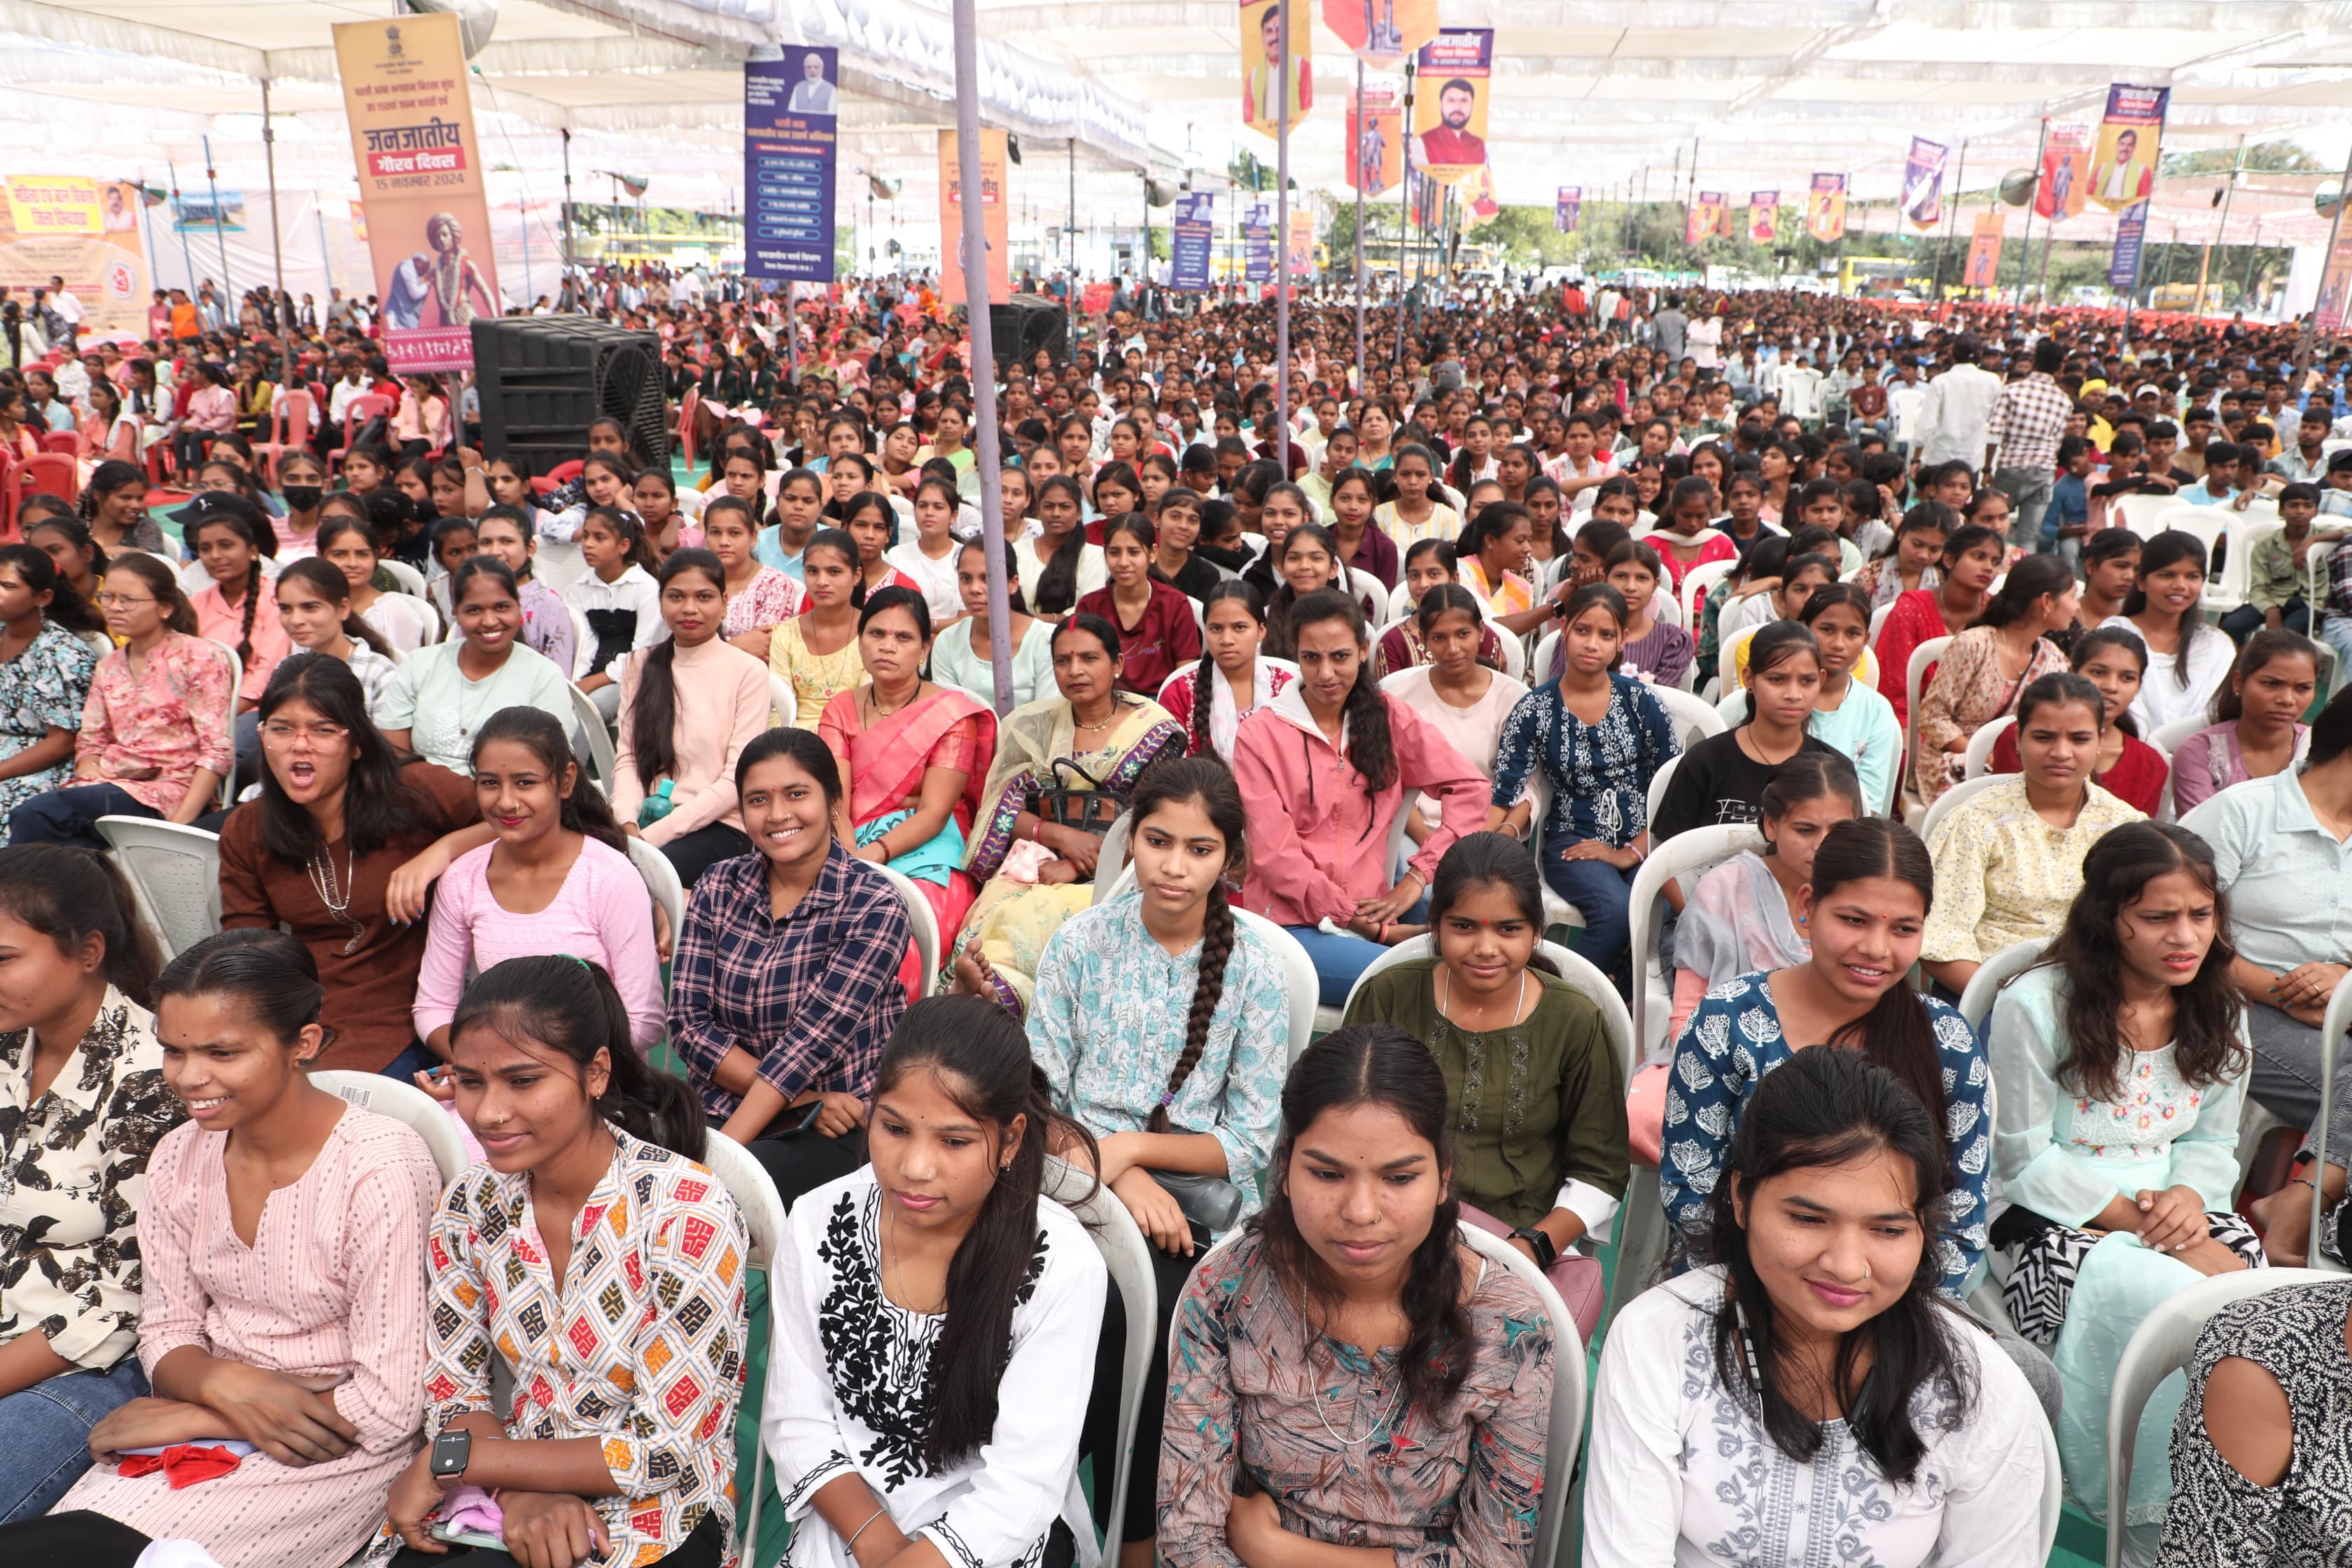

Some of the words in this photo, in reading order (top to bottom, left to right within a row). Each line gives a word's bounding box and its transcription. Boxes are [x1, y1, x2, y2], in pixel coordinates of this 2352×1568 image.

[363, 115, 461, 152] जनजातीय
[377, 155, 413, 173] गौरव
[416, 152, 456, 169] दिवस
[375, 179, 388, 190] 15
[391, 175, 432, 188] नवम्बर
[434, 173, 465, 186] 2024
